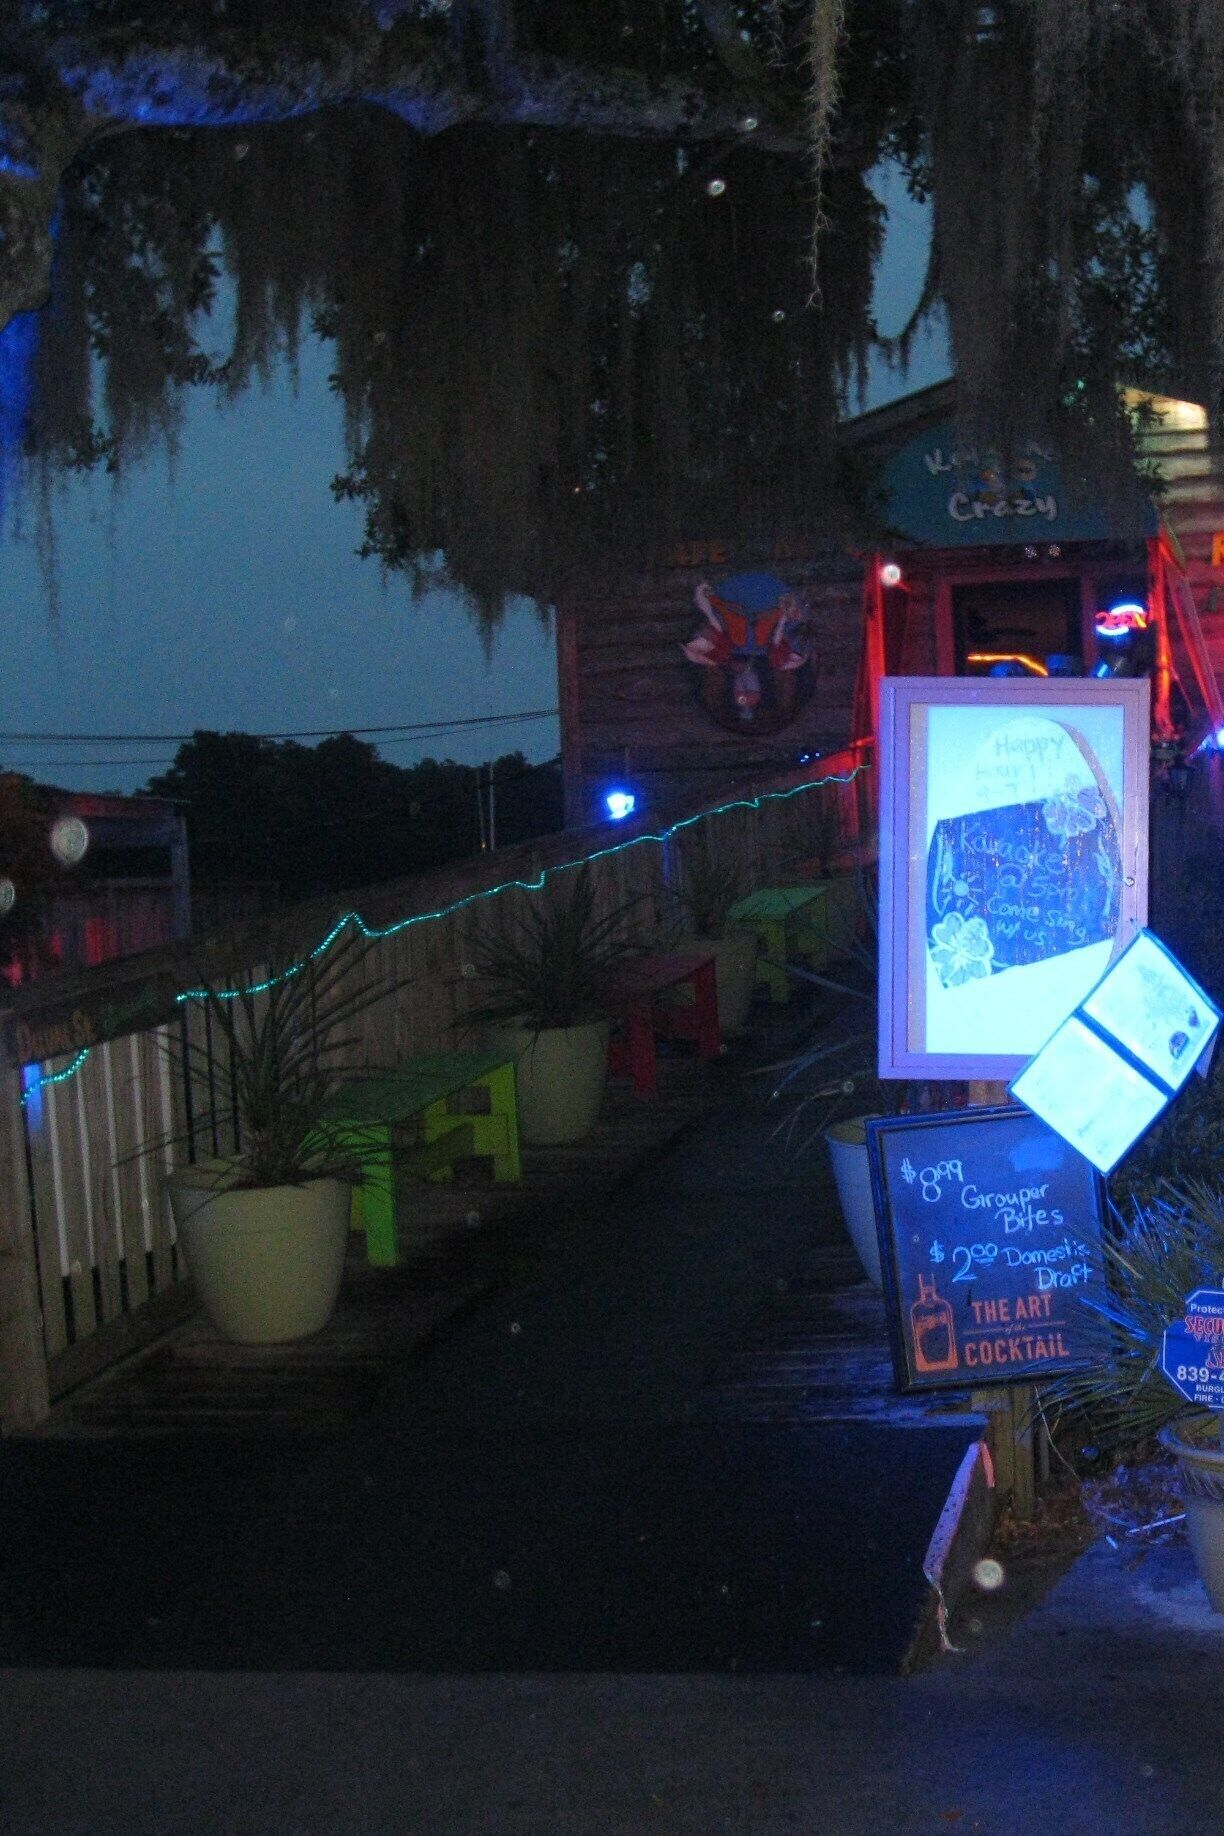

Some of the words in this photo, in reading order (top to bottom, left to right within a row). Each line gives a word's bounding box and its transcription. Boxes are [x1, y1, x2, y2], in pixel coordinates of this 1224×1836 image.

[947, 492, 1058, 522] Crazy
[995, 734, 1066, 763] Happy
[959, 820, 1065, 875] Karaoke
[961, 1183, 1050, 1213] Grouper
[994, 1205, 1064, 1234] Bites
[1034, 1262, 1093, 1291] Draft
[971, 1298, 1011, 1324] THE
[1015, 1293, 1053, 1320] ART
[964, 1332, 1070, 1367] COCKTAIL
[1193, 1394, 1214, 1403] FIRE
